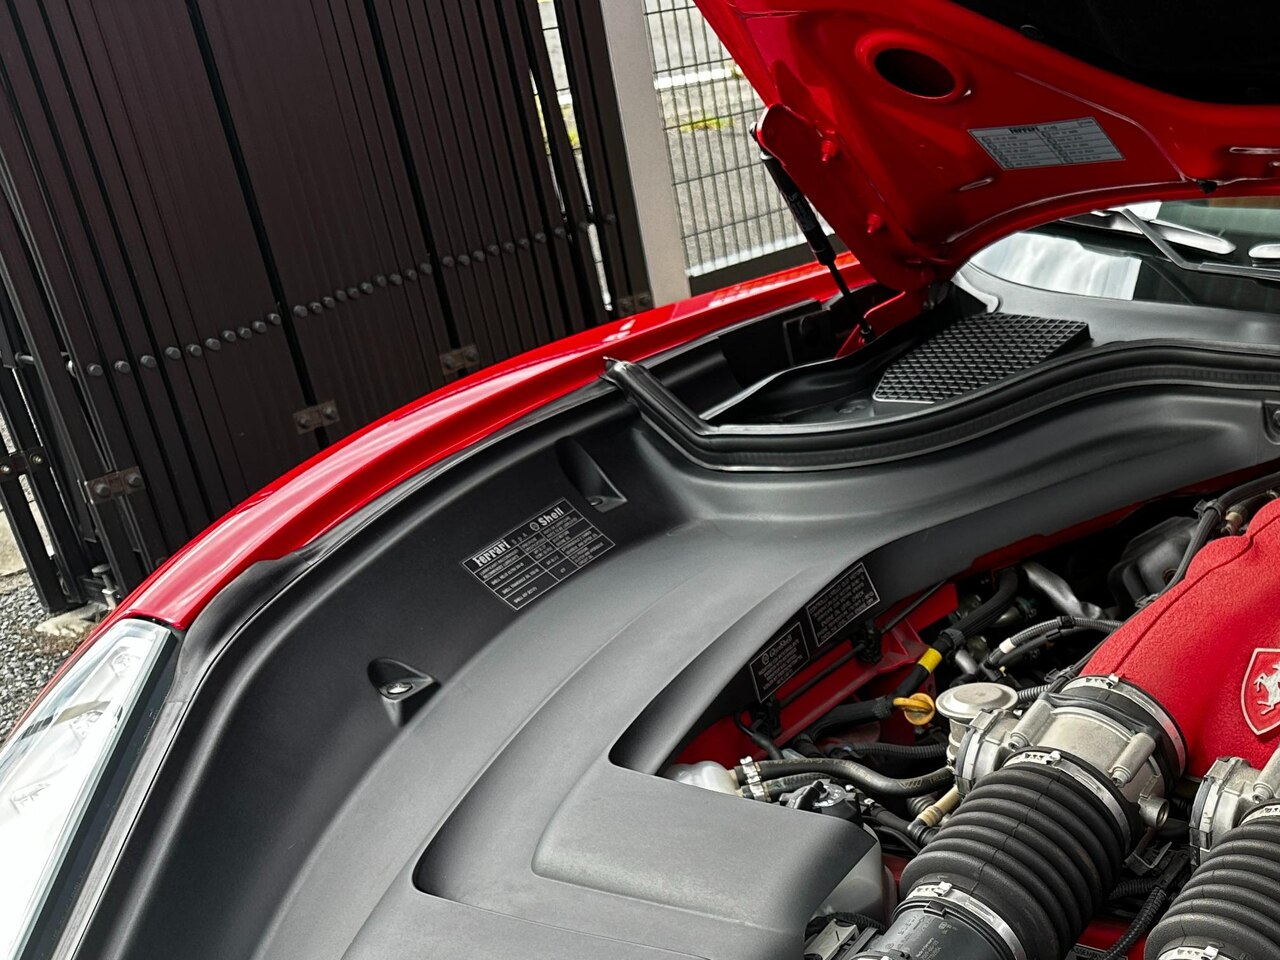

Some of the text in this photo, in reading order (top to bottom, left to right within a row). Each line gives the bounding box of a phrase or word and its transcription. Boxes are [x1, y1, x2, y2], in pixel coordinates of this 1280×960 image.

[1009, 125, 1040, 134] Ferrari
[538, 507, 564, 526] Shell
[473, 539, 511, 567] Ferrari
